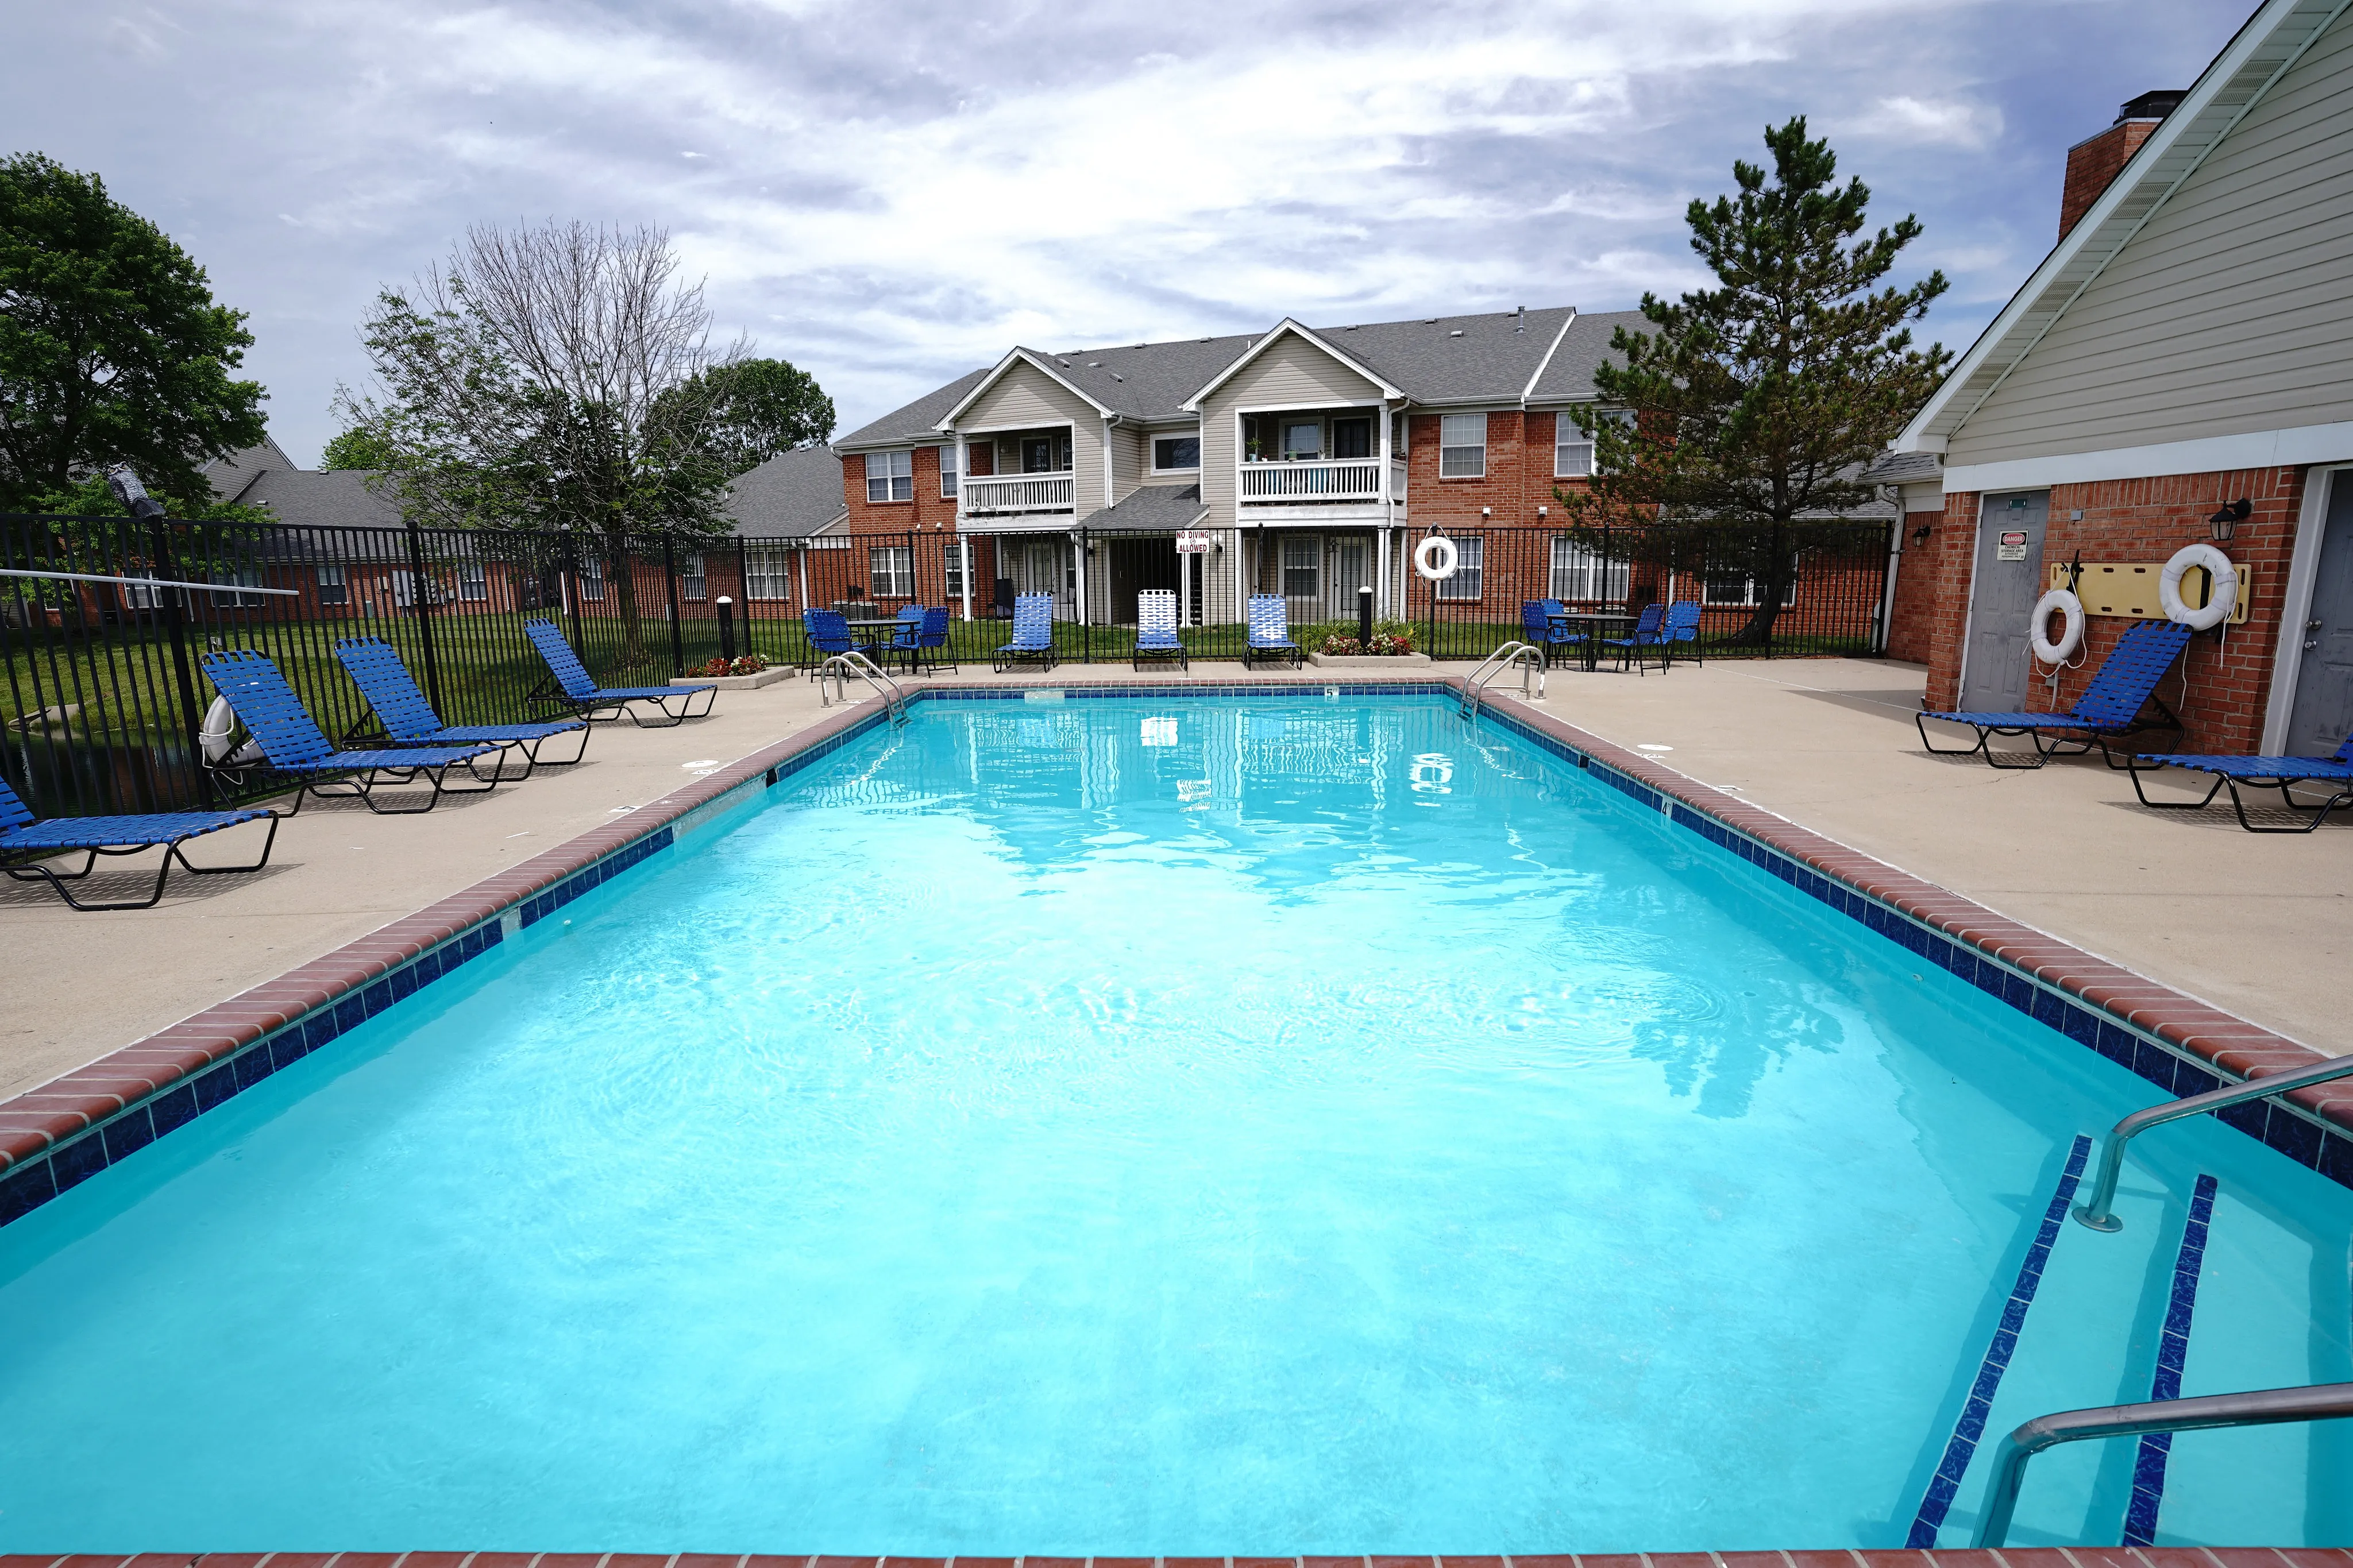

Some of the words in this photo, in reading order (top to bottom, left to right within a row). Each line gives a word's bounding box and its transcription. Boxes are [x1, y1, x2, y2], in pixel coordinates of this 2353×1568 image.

[1176, 531, 1185, 539] NO
[1189, 531, 1209, 539] DIVING
[1179, 544, 1207, 553] ALLOWED
[1327, 689, 1333, 697] 5
[1662, 802, 1667, 815] 4
